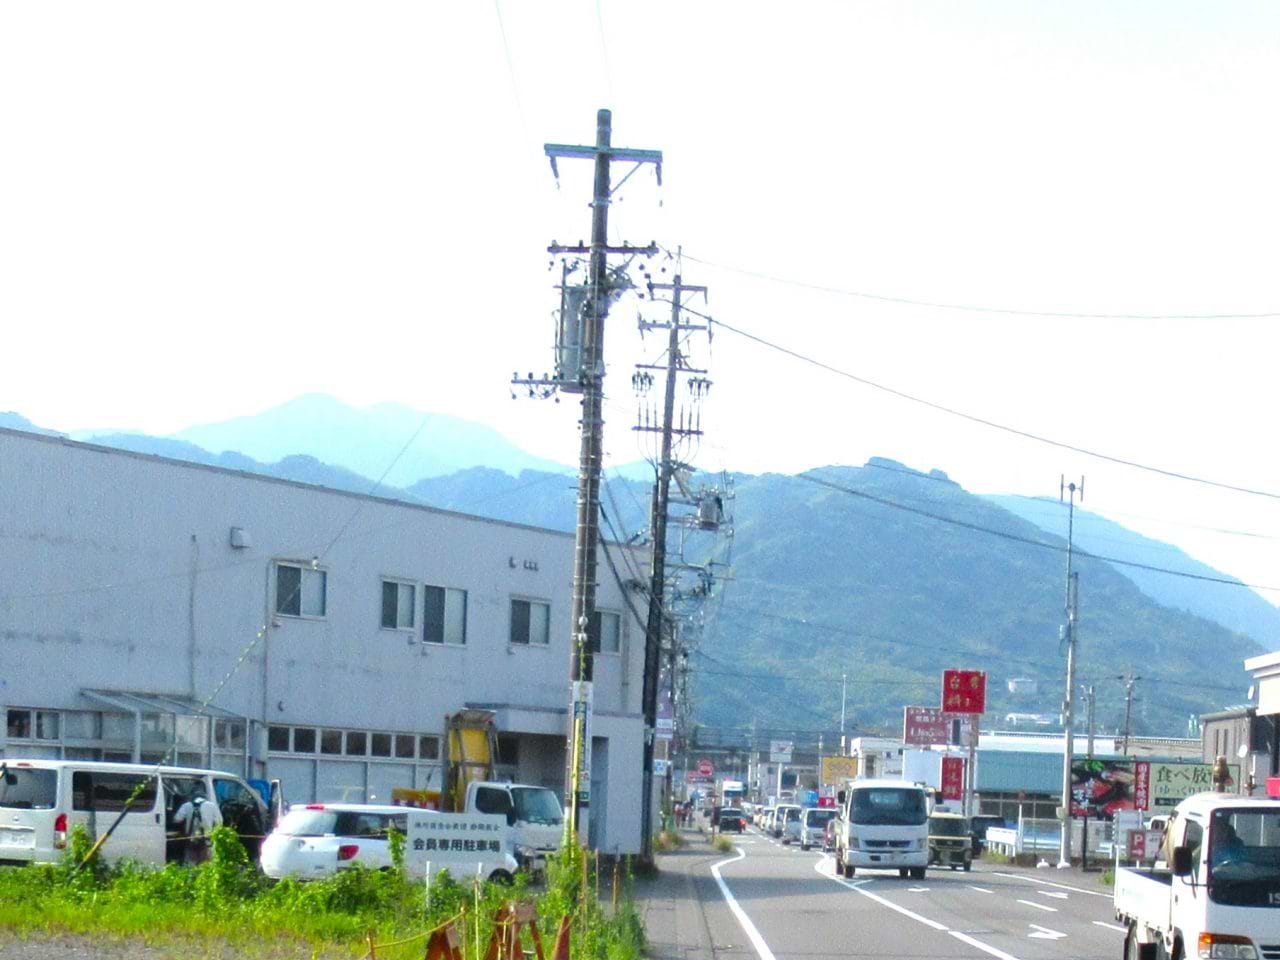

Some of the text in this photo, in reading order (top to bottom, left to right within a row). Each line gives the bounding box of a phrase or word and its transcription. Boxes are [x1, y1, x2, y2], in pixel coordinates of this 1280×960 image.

[1156, 765, 1213, 784] 食べ放
[413, 837, 500, 853] 会員専用駐車場
